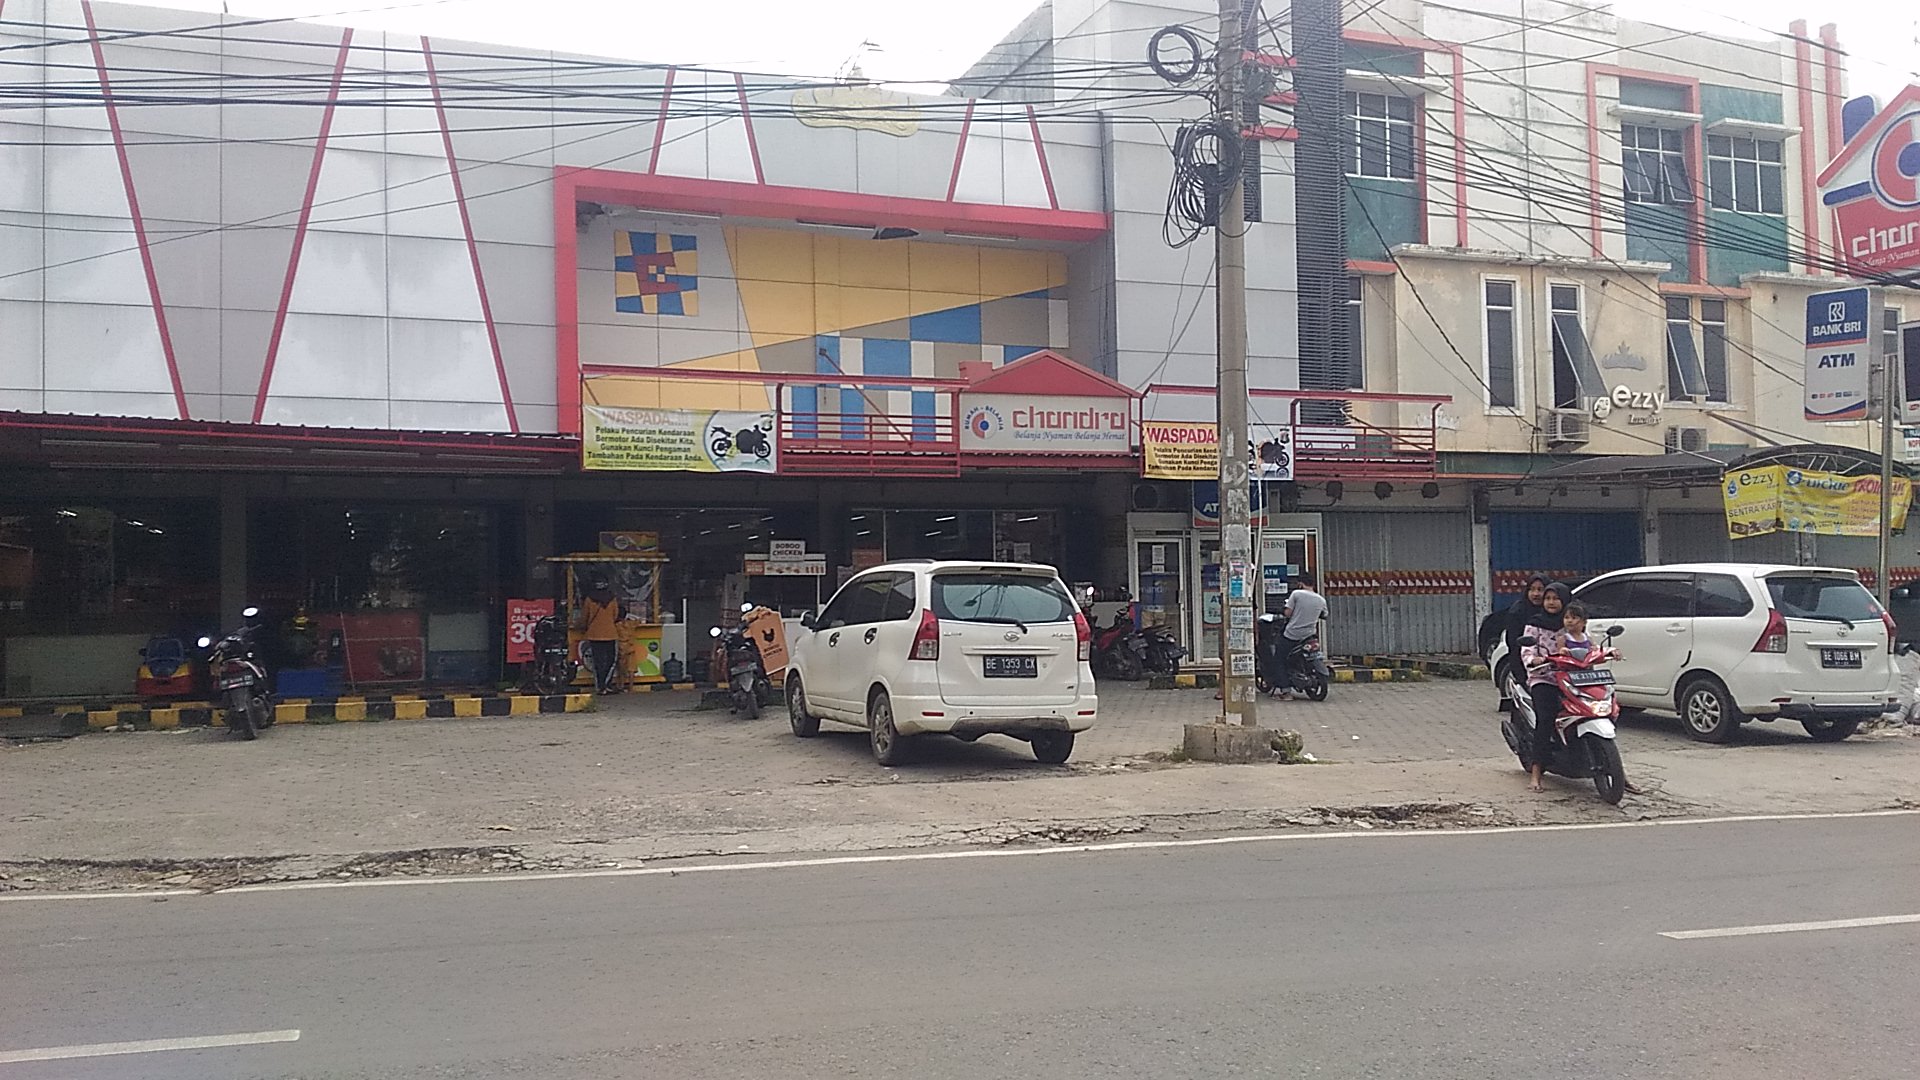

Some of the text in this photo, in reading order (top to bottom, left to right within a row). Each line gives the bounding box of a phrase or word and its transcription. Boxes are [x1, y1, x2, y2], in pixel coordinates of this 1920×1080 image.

[1813, 321, 1861, 337] BANK BRI
[1818, 353, 1855, 368] ATM
[1612, 385, 1664, 413] ezzy
[1012, 406, 1125, 430] chandra
[596, 426, 695, 437] Pelaku Pencurian Kendaraan
[1014, 430, 1125, 442] Belanja Nyaman Belanja Hemat
[596, 434, 629, 443] Bermotor
[631, 435, 645, 444] Ada
[646, 436, 677, 444] Disekitar
[600, 443, 691, 454] Gunakan Kunci Pengaman
[588, 451, 624, 460] Tambahan
[626, 452, 643, 460] Pada
[645, 453, 682, 461] Kendaraan
[1740, 473, 1774, 486] ezzy
[1203, 503, 1220, 513] AT
[1728, 505, 1760, 517] SENTRA
[1270, 541, 1285, 549] BNI
[986, 658, 1035, 669] BE 1353 CX
